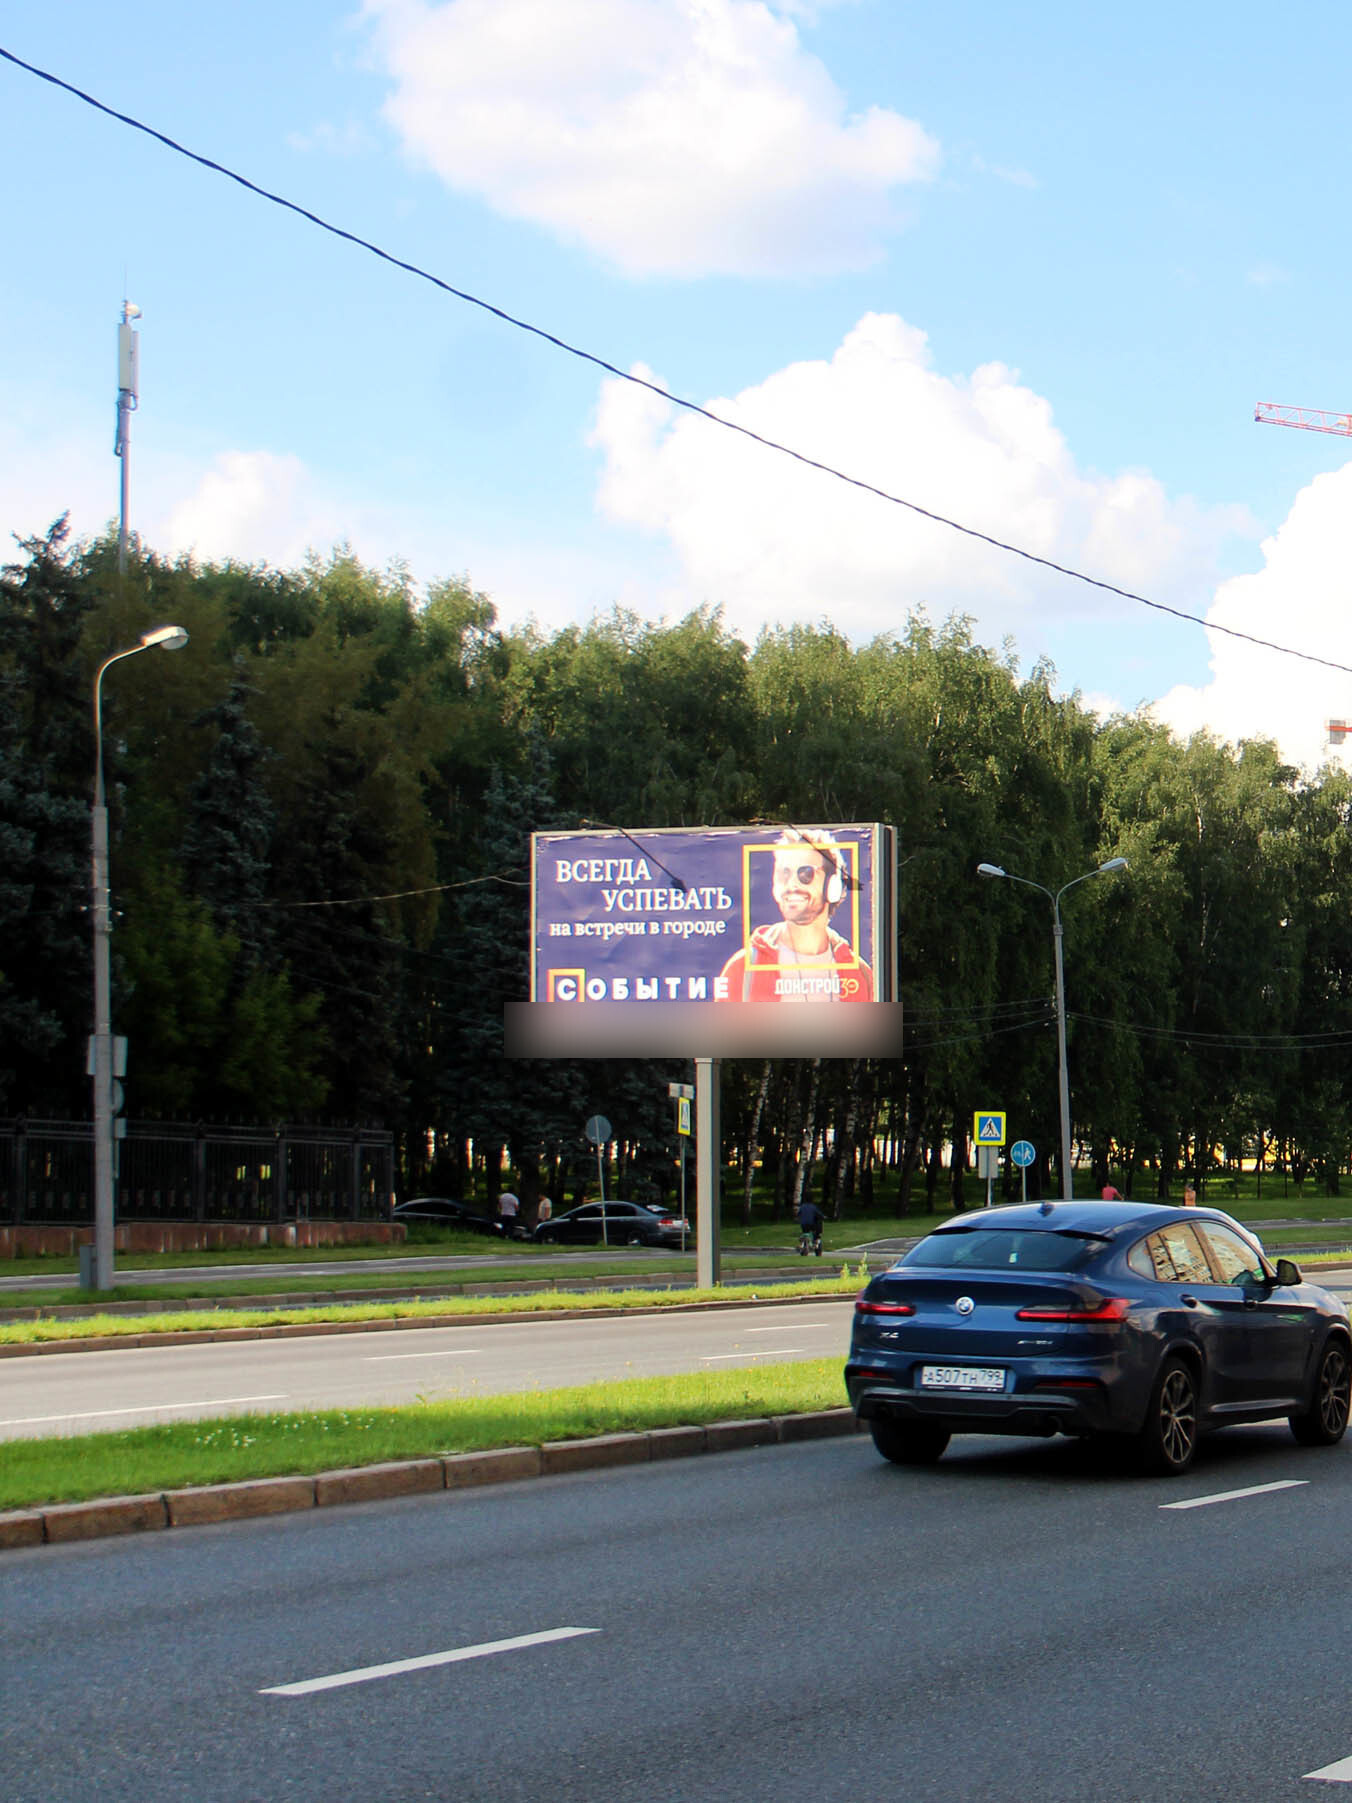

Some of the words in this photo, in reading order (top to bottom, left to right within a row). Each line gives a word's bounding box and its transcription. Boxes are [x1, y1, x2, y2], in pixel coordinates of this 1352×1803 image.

[555, 858, 652, 885] ВСЕГДА
[601, 887, 733, 912] УСПЕВАТЬ
[549, 922, 571, 937] на
[575, 921, 646, 940] встречи
[649, 922, 660, 935] в
[663, 920, 727, 938] городе
[556, 976, 729, 1001] СОБЫТИЕ
[774, 974, 841, 995] ДОНСТРОЙ
